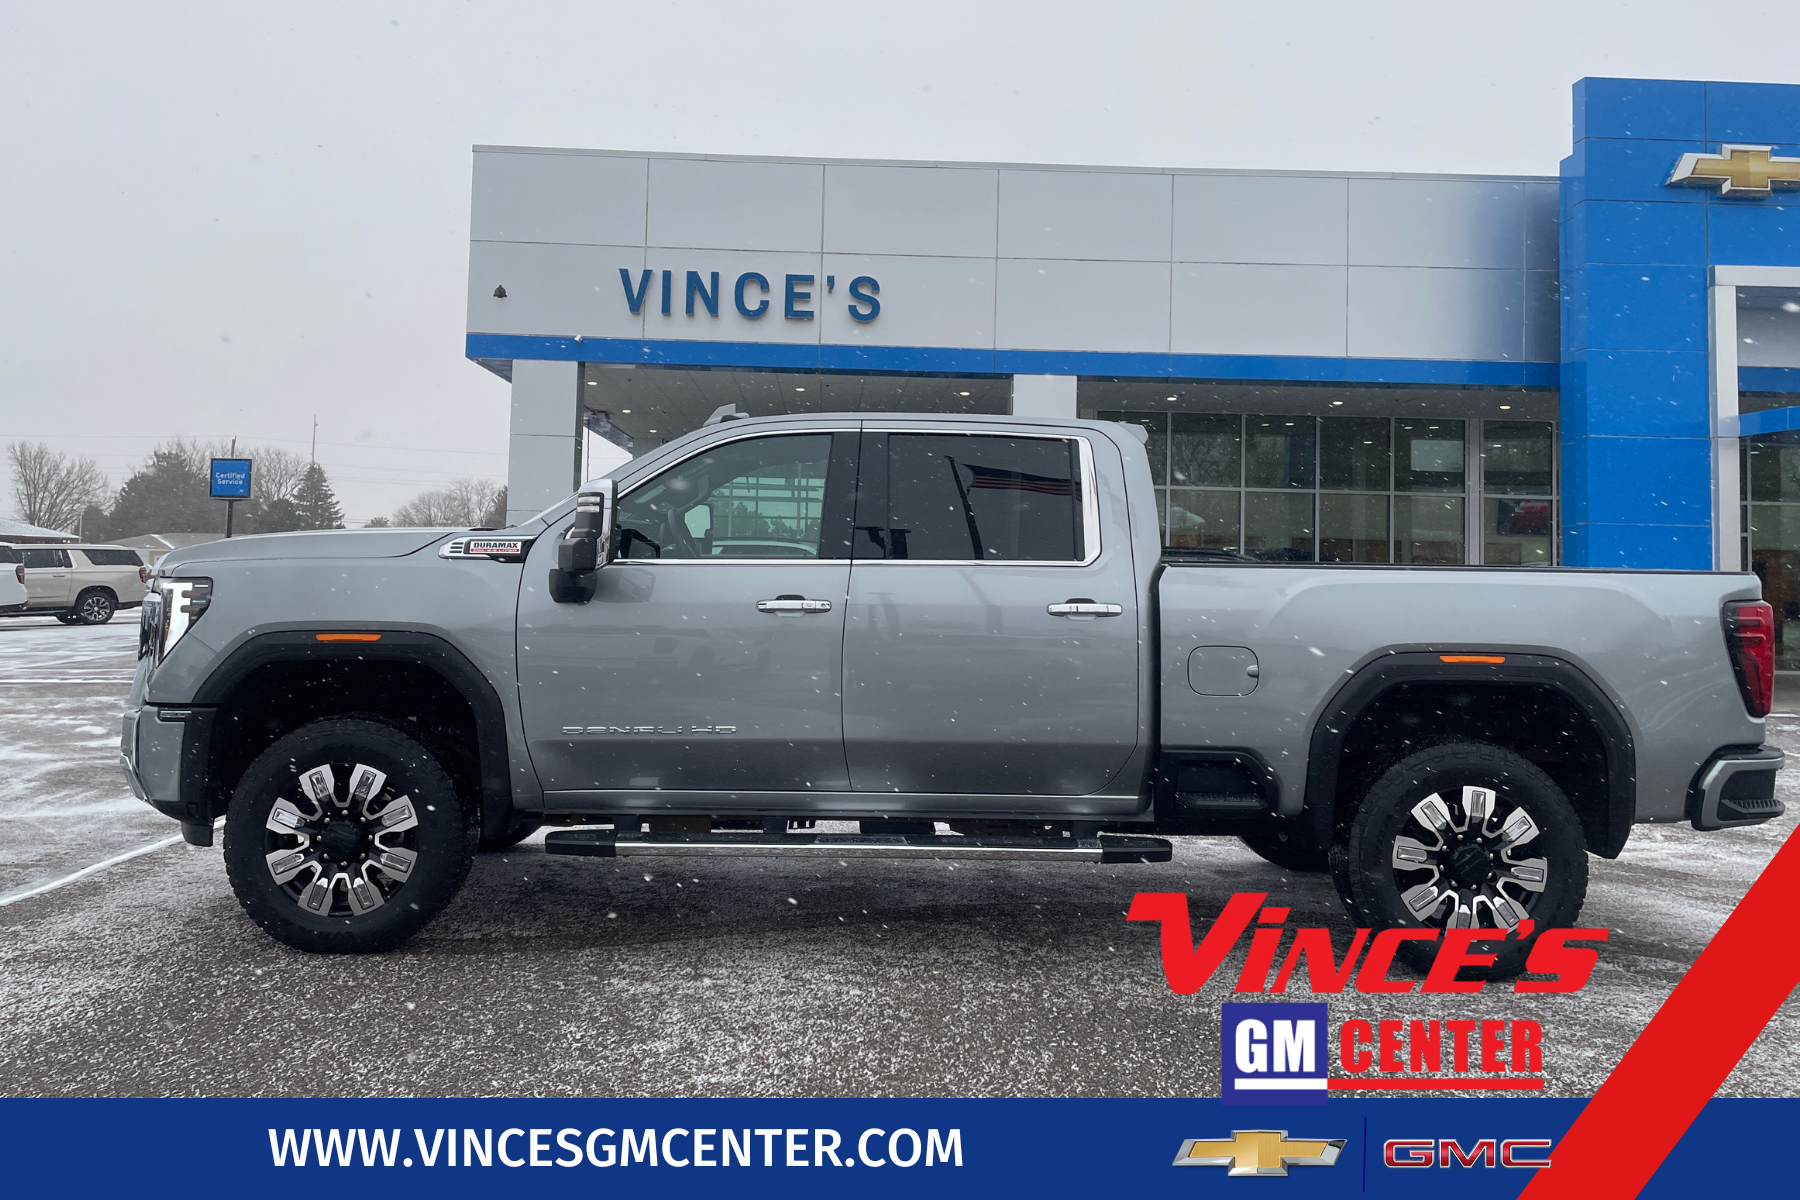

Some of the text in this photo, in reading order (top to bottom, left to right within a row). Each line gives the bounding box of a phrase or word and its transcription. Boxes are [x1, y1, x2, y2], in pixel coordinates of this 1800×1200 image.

[618, 268, 881, 323] VINCE'S
[562, 725, 737, 734] DENALI HD
